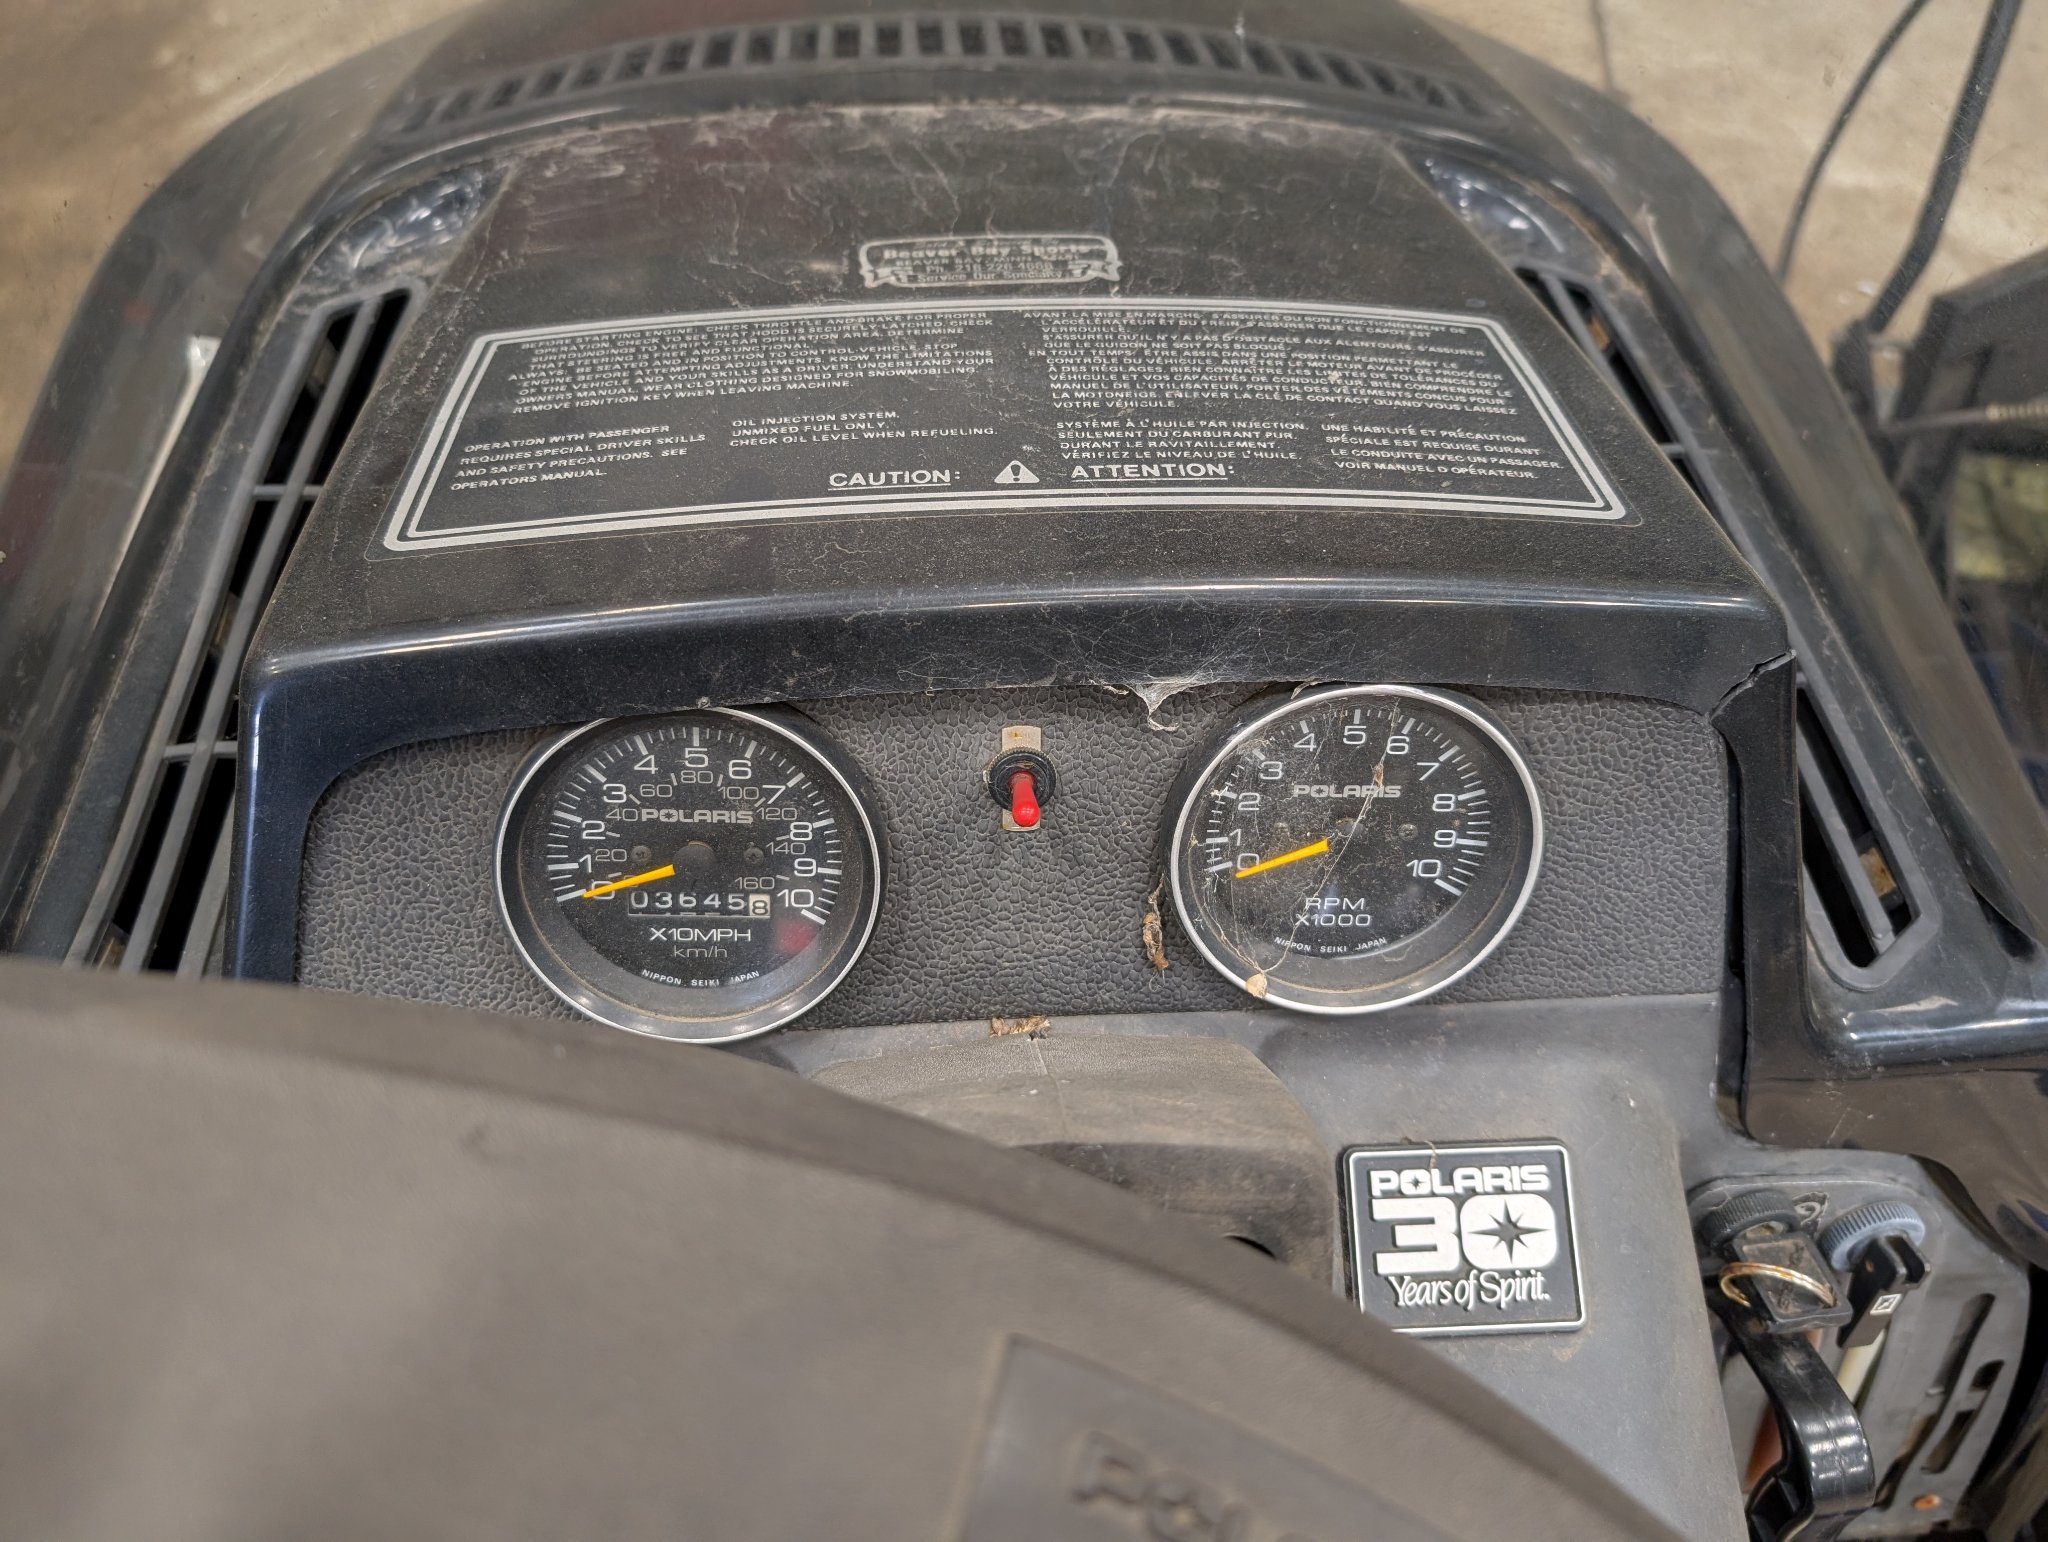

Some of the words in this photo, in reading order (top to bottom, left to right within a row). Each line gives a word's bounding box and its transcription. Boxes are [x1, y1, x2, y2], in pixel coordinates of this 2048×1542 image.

[523, 376, 573, 387] ENGINE
[577, 371, 630, 381] BEFORE
[635, 363, 721, 376] ATTEMPTING
[725, 357, 825, 369] ADJUSTMENTS.
[905, 350, 993, 359] LIMITATIONS
[516, 393, 573, 404] OWNERS
[577, 387, 639, 398] MANUAL.
[643, 384, 683, 392] WEAR
[687, 377, 758, 389] CLOTHING
[762, 373, 832, 384] DESIGNED
[837, 370, 864, 378] FOR
[868, 366, 979, 377] SNOWMOBILING.
[1136, 382, 1242, 390] L'UTILISATEUR.
[1246, 384, 1299, 392] PORTER
[1303, 386, 1329, 394] DES
[1332, 385, 1412, 398] VÊTEMENTS
[1470, 397, 1505, 405] POUR
[512, 402, 572, 414] REMOVE
[575, 396, 639, 408] IGNITION
[643, 392, 672, 401] KEY
[675, 389, 715, 399] WHEN
[720, 384, 782, 395] LEAVING
[787, 381, 853, 390] MACHINE.
[1106, 399, 1180, 408] VÉHICULE.
[1255, 392, 1282, 400] CLÉ
[1306, 394, 1369, 404] CONTACT
[1374, 398, 1422, 408] QUAND
[1424, 402, 1461, 411] VOUS
[1464, 405, 1518, 415] LAISSEZ
[732, 419, 756, 427] OIL
[761, 414, 836, 425] INJECTION
[840, 411, 900, 420] SYSTEM.
[1056, 419, 1121, 428] SYSTÈME
[1126, 419, 1136, 428] À
[1232, 421, 1309, 430] INJECTION.
[730, 438, 775, 446] CHECK
[782, 436, 808, 444] OIL
[812, 433, 859, 442] LEVEL
[863, 430, 906, 439] WHEN
[911, 427, 998, 438] REFUELING.
[732, 426, 799, 436] UNMIXED
[804, 424, 841, 432] FUEL
[845, 422, 890, 430] ONLY.
[1172, 431, 1261, 439] CARBURANT
[1265, 431, 1297, 439] PUR.
[1353, 425, 1415, 435] HABILITÉ
[1440, 428, 1526, 442] PRÉCAUTION
[465, 437, 545, 453] OPERATION
[549, 433, 584, 443] WITH
[588, 425, 670, 438] PASSENGER
[1060, 441, 1120, 449] DURANT
[1148, 440, 1280, 449] RAVITAILLEMENT.
[1325, 433, 1390, 446] SPÉCIALE
[1394, 439, 1418, 447] EST
[1422, 440, 1481, 451] REQUISE
[1484, 445, 1540, 455] DURANT
[460, 450, 531, 465] REQUIRES
[535, 445, 592, 457] SPECIAL
[597, 438, 652, 450] DRIVER
[656, 435, 706, 445] SKILLS
[1062, 450, 1129, 459] VÉRIFIEZ
[1351, 449, 1423, 460] CONDUITE
[1427, 453, 1463, 462] AVEC
[1491, 457, 1564, 469] PASSAGER.
[455, 467, 487, 477] AND
[489, 461, 546, 474] SAFETY
[549, 451, 653, 467] PRECAUTIONS.
[661, 448, 687, 457] SEE
[1071, 463, 1235, 478] ATTENTION:
[1335, 461, 1371, 469] VOIR
[1375, 463, 1434, 473] MANUEL
[451, 475, 537, 490] OPERATORS
[541, 470, 607, 481] MANUAL.
[829, 469, 960, 486] CAUTION:
[1293, 733, 1317, 752] 4
[1343, 725, 1367, 744] 5
[1386, 735, 1410, 755] 6
[634, 755, 658, 774] 4
[684, 748, 709, 767] 5
[680, 771, 714, 784] 80
[729, 760, 752, 779] 6
[1259, 761, 1283, 780] 3
[1416, 762, 1441, 781] 7
[603, 784, 627, 803] 3
[640, 784, 673, 798] 60
[719, 786, 759, 800] 100
[762, 785, 786, 804] 7
[1293, 784, 1401, 798] POLARIS
[1237, 792, 1260, 811] 2
[1432, 793, 1456, 812] 8
[606, 808, 639, 822] 40
[641, 809, 753, 823] POLARIS
[756, 807, 798, 820] 120
[582, 821, 606, 840] 2
[790, 822, 813, 841] 8
[1229, 829, 1241, 846] 1
[1433, 829, 1457, 847] 9
[595, 849, 627, 862] 20
[765, 842, 806, 855] 140
[579, 854, 593, 872] 1
[794, 858, 818, 876] 9
[1237, 853, 1260, 871] 0
[1407, 859, 1441, 878] 10
[734, 877, 775, 889] 160
[778, 889, 814, 907] 10
[1305, 897, 1365, 910] RPM
[1295, 913, 1370, 926] X1000
[649, 928, 751, 942] X10MPH
[674, 945, 727, 958] km/h
[1275, 936, 1311, 951] NIPPON
[1320, 945, 1347, 953] SEIKI
[1356, 936, 1387, 951] JAPAN
[642, 969, 681, 986] NIPPON
[691, 978, 719, 987] SEIKI
[1370, 1165, 1551, 1197] POLARIS
[1371, 1193, 1558, 1275] 30
[1388, 1275, 1451, 1306] Years
[1455, 1269, 1477, 1311] of
[1480, 1269, 1550, 1310] Spirit.
